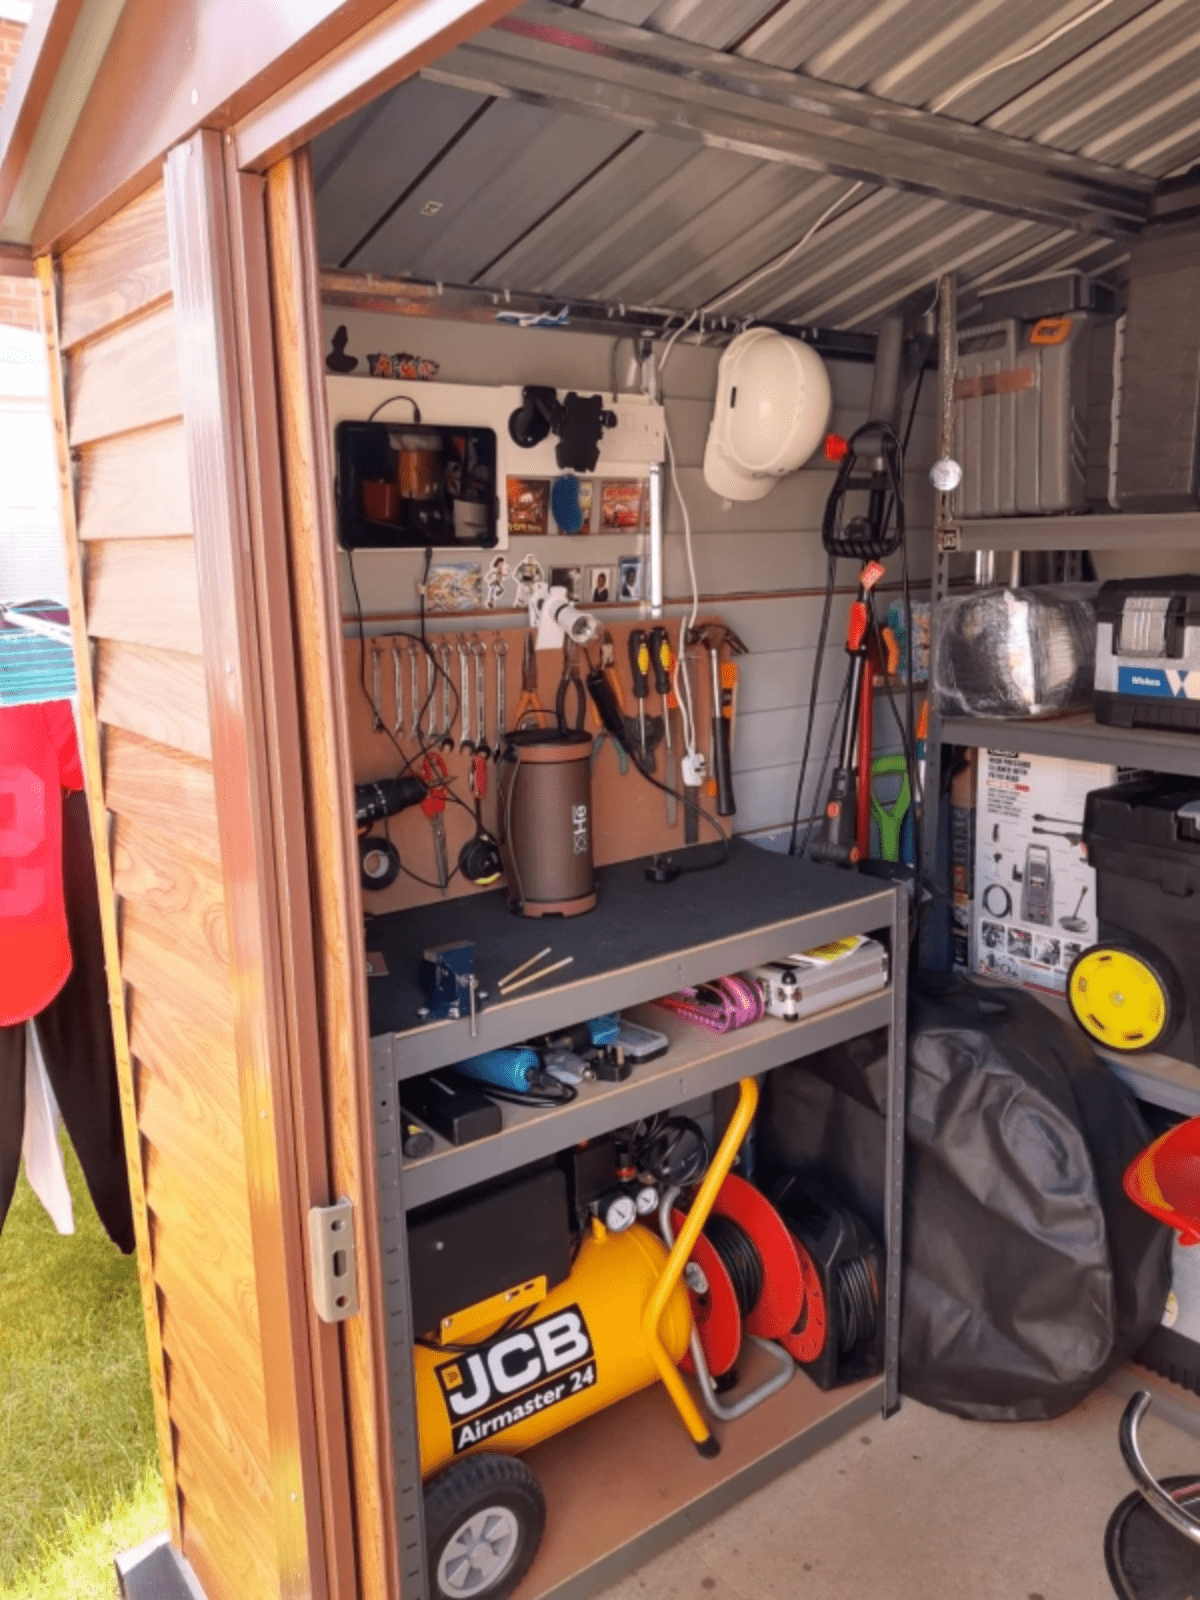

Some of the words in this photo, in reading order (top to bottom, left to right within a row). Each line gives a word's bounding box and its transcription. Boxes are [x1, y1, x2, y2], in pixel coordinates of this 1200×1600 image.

[449, 1312, 590, 1415] JCB
[458, 1384, 566, 1449] Airmaster
[570, 1365, 594, 1392] 24
